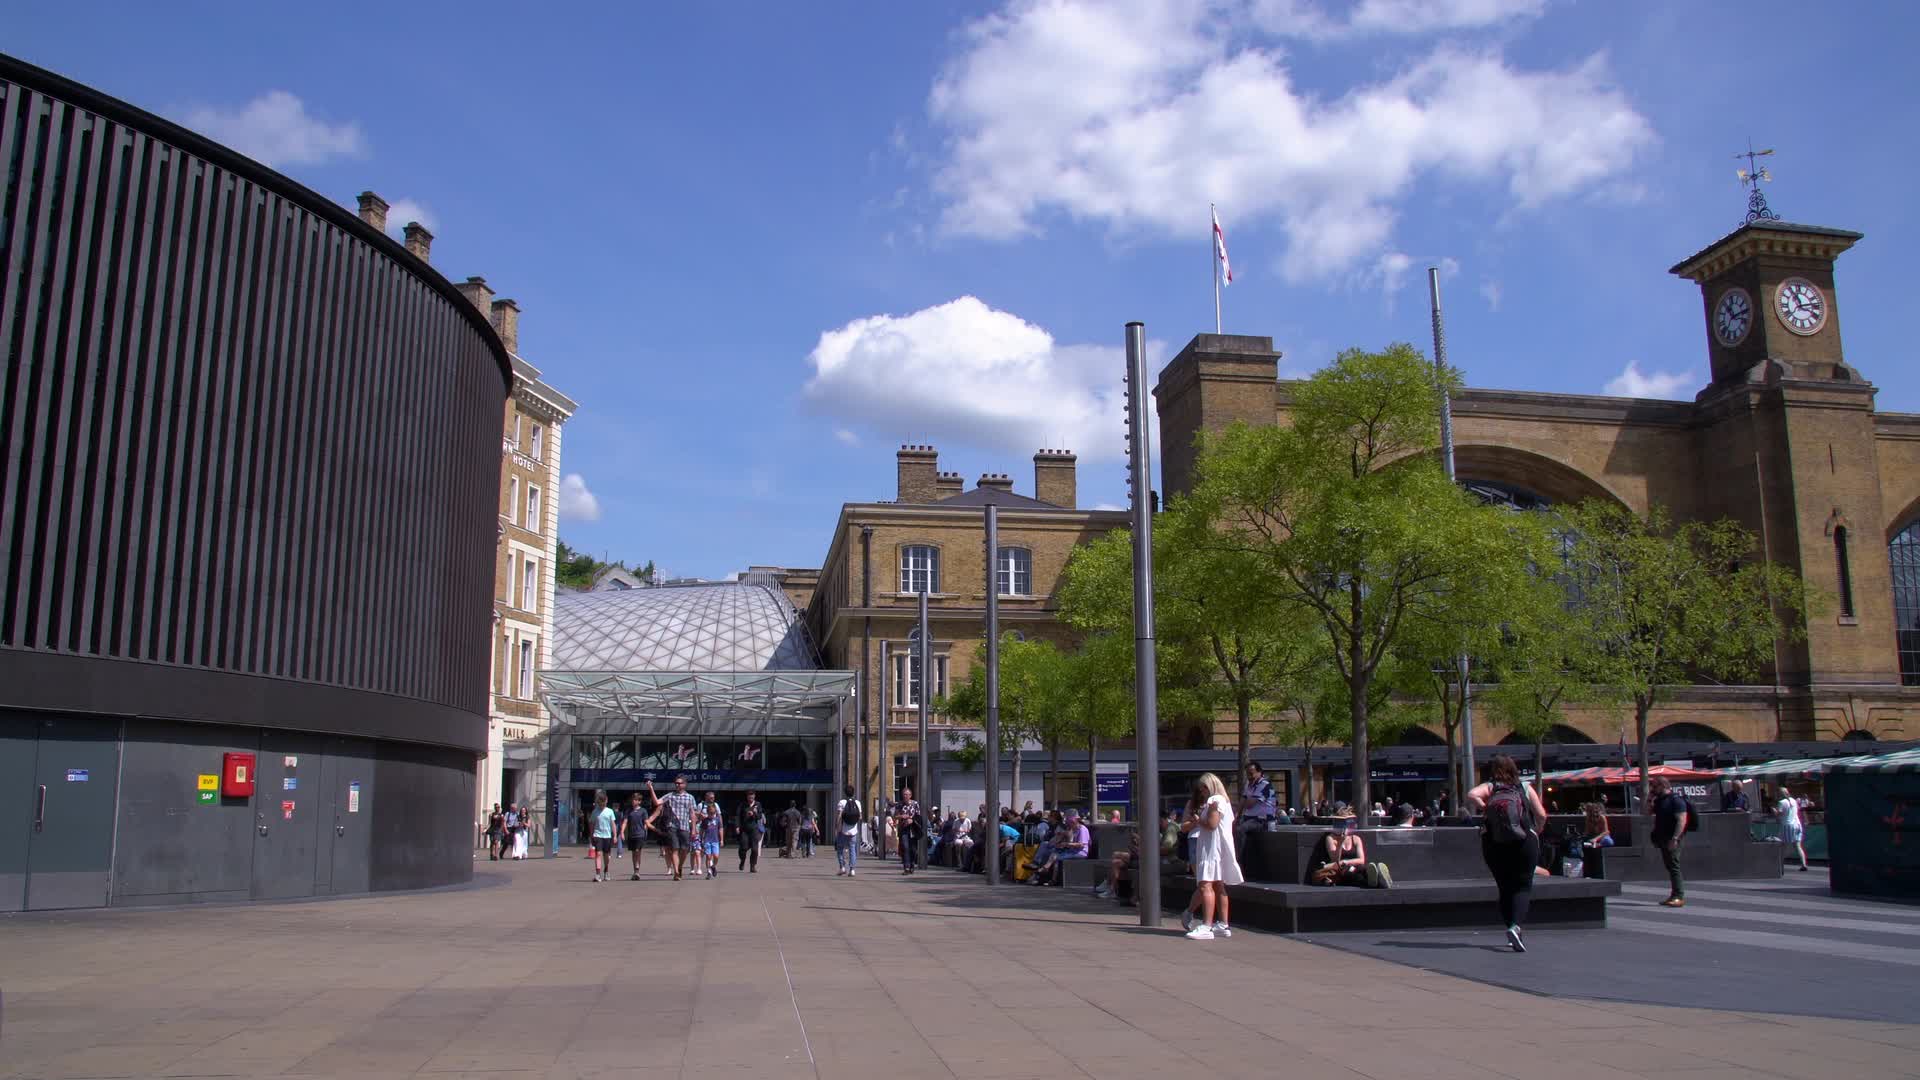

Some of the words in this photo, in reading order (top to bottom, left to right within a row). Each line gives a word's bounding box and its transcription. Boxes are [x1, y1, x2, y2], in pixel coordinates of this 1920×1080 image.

[512, 454, 535, 472] HOTEL
[701, 772, 721, 780] Cross
[1684, 785, 1706, 796] BOSS
